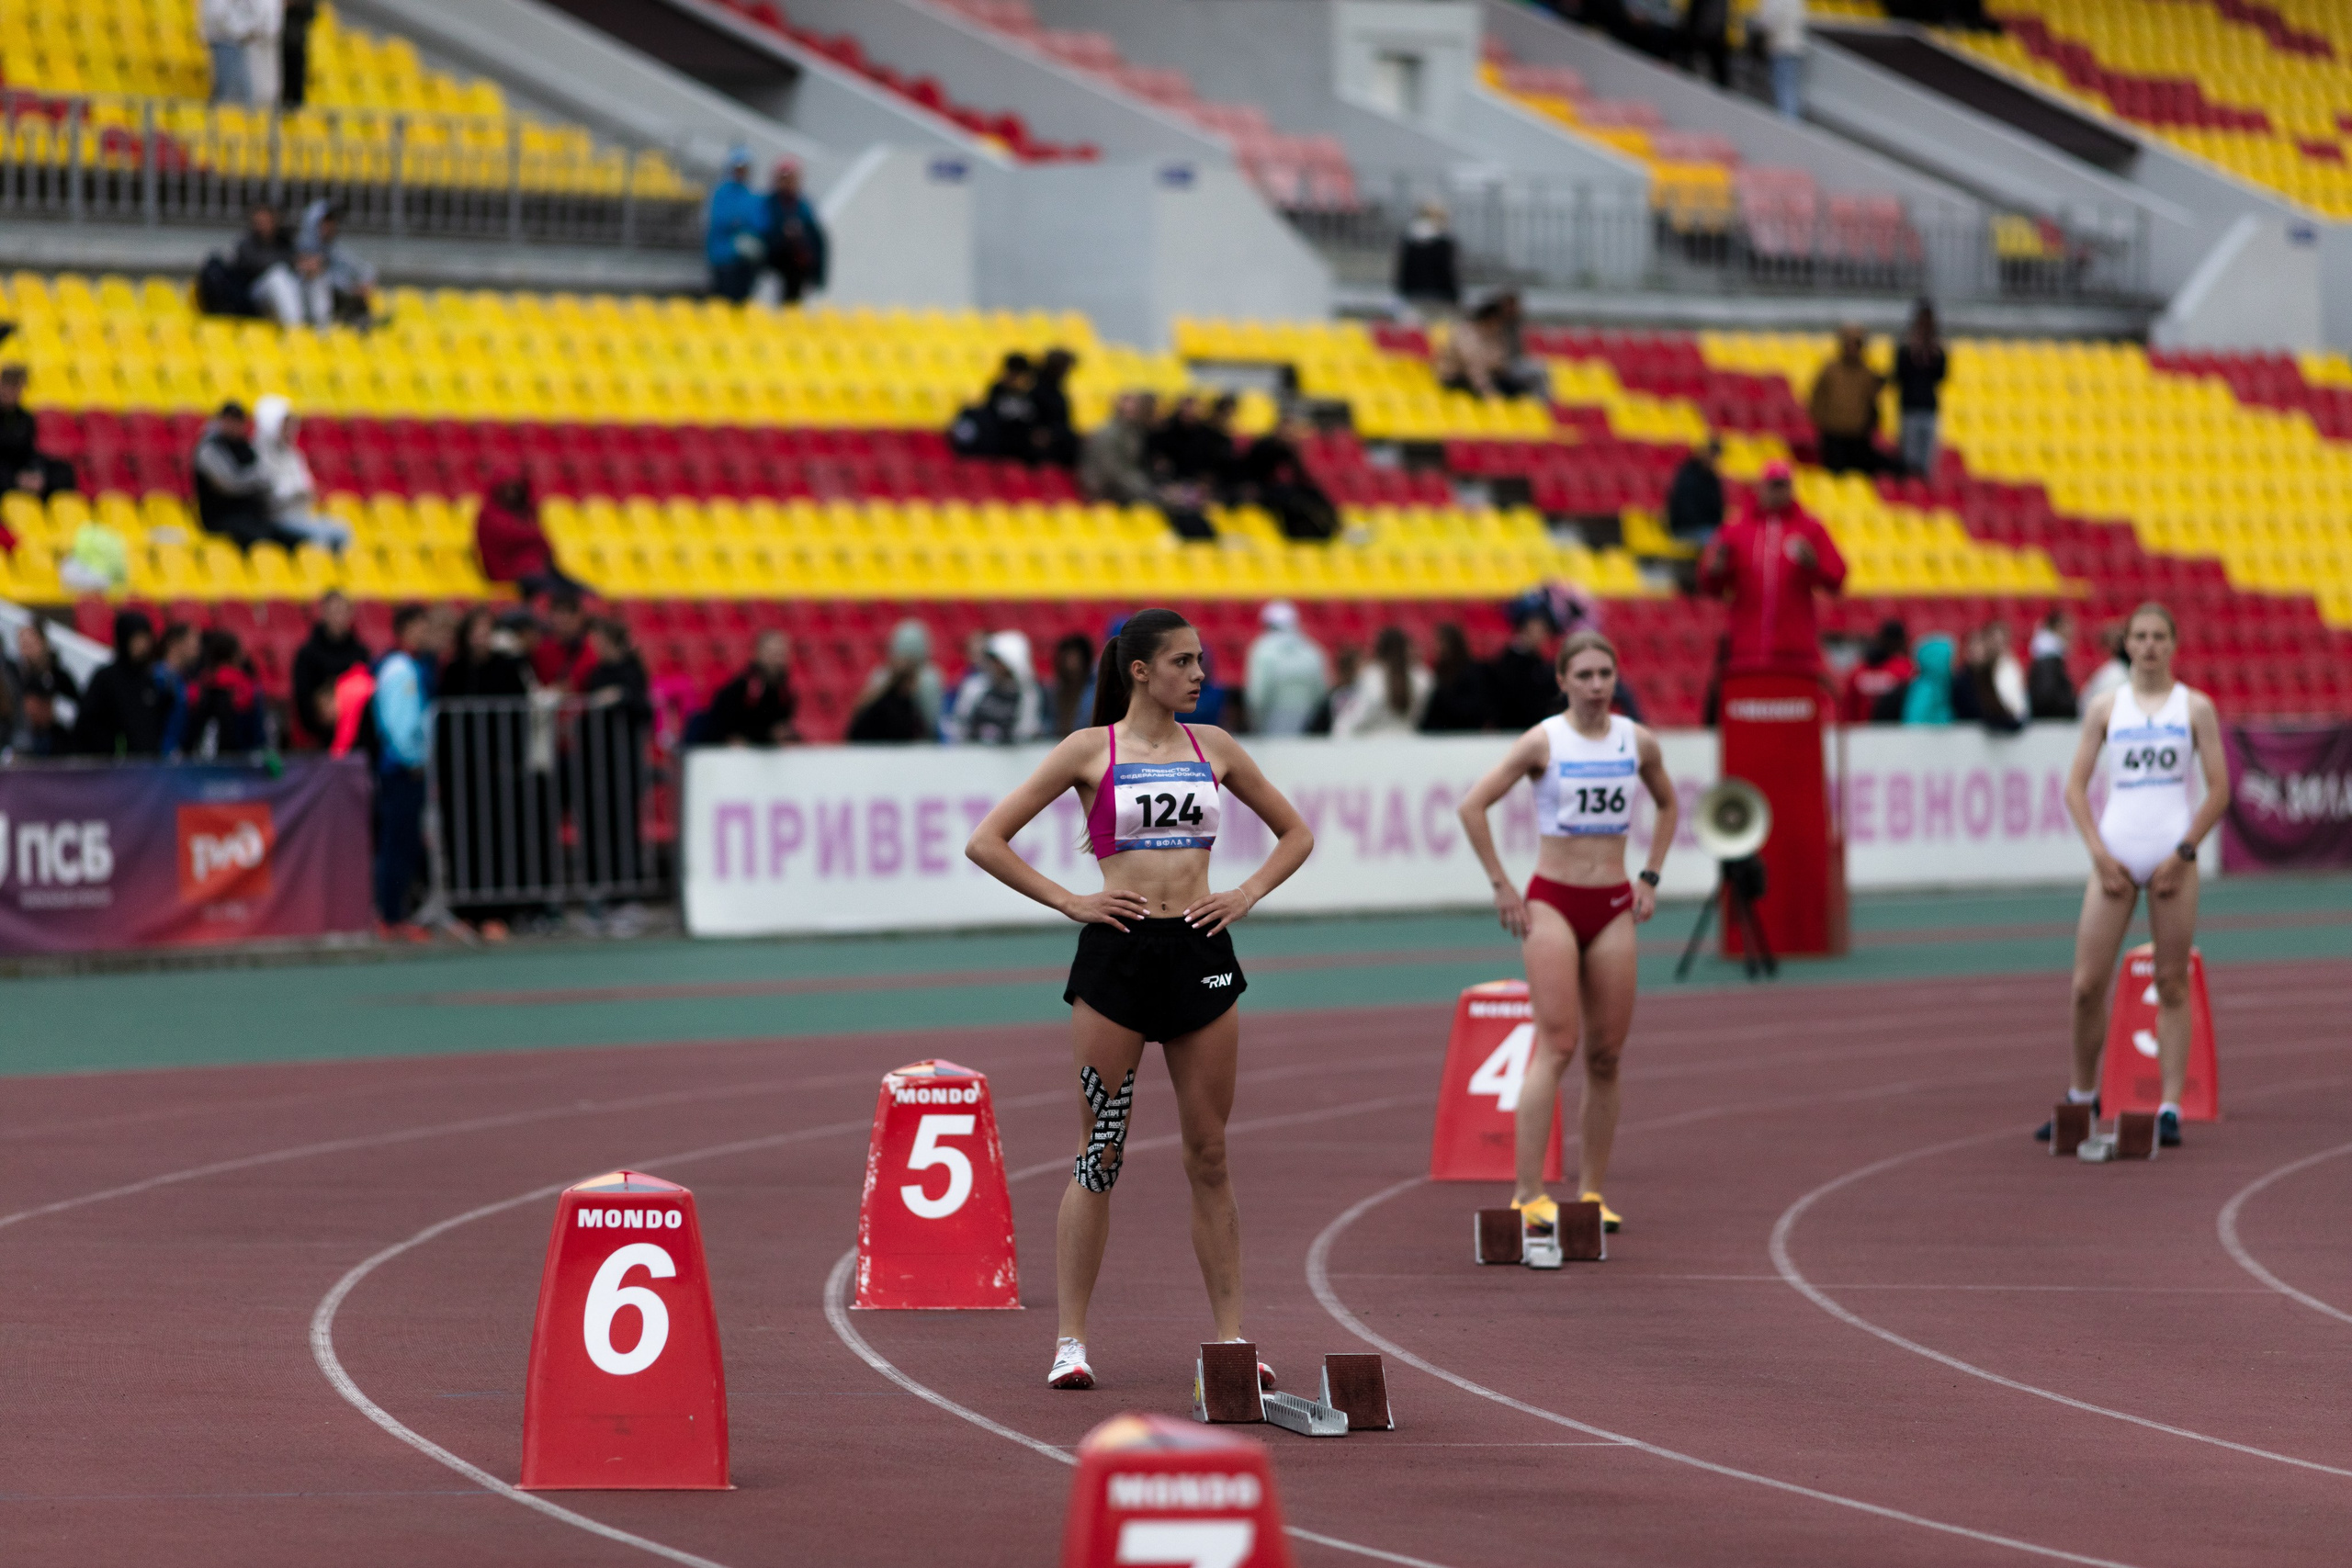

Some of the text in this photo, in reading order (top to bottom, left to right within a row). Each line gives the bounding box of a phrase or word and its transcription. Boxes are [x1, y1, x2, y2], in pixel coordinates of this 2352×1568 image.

[2123, 746, 2177, 770] 490
[1135, 793, 1204, 828] 124
[1576, 786, 1626, 814] 136
[17, 820, 114, 885] ПСБ
[1156, 839, 1182, 847] ВФЛА
[1202, 972, 1233, 989] RAY
[1467, 1021, 1537, 1111] 4
[895, 1088, 978, 1104] MONDO
[900, 1113, 976, 1219] 5
[577, 1208, 683, 1229] MONDO
[583, 1242, 677, 1375] 6
